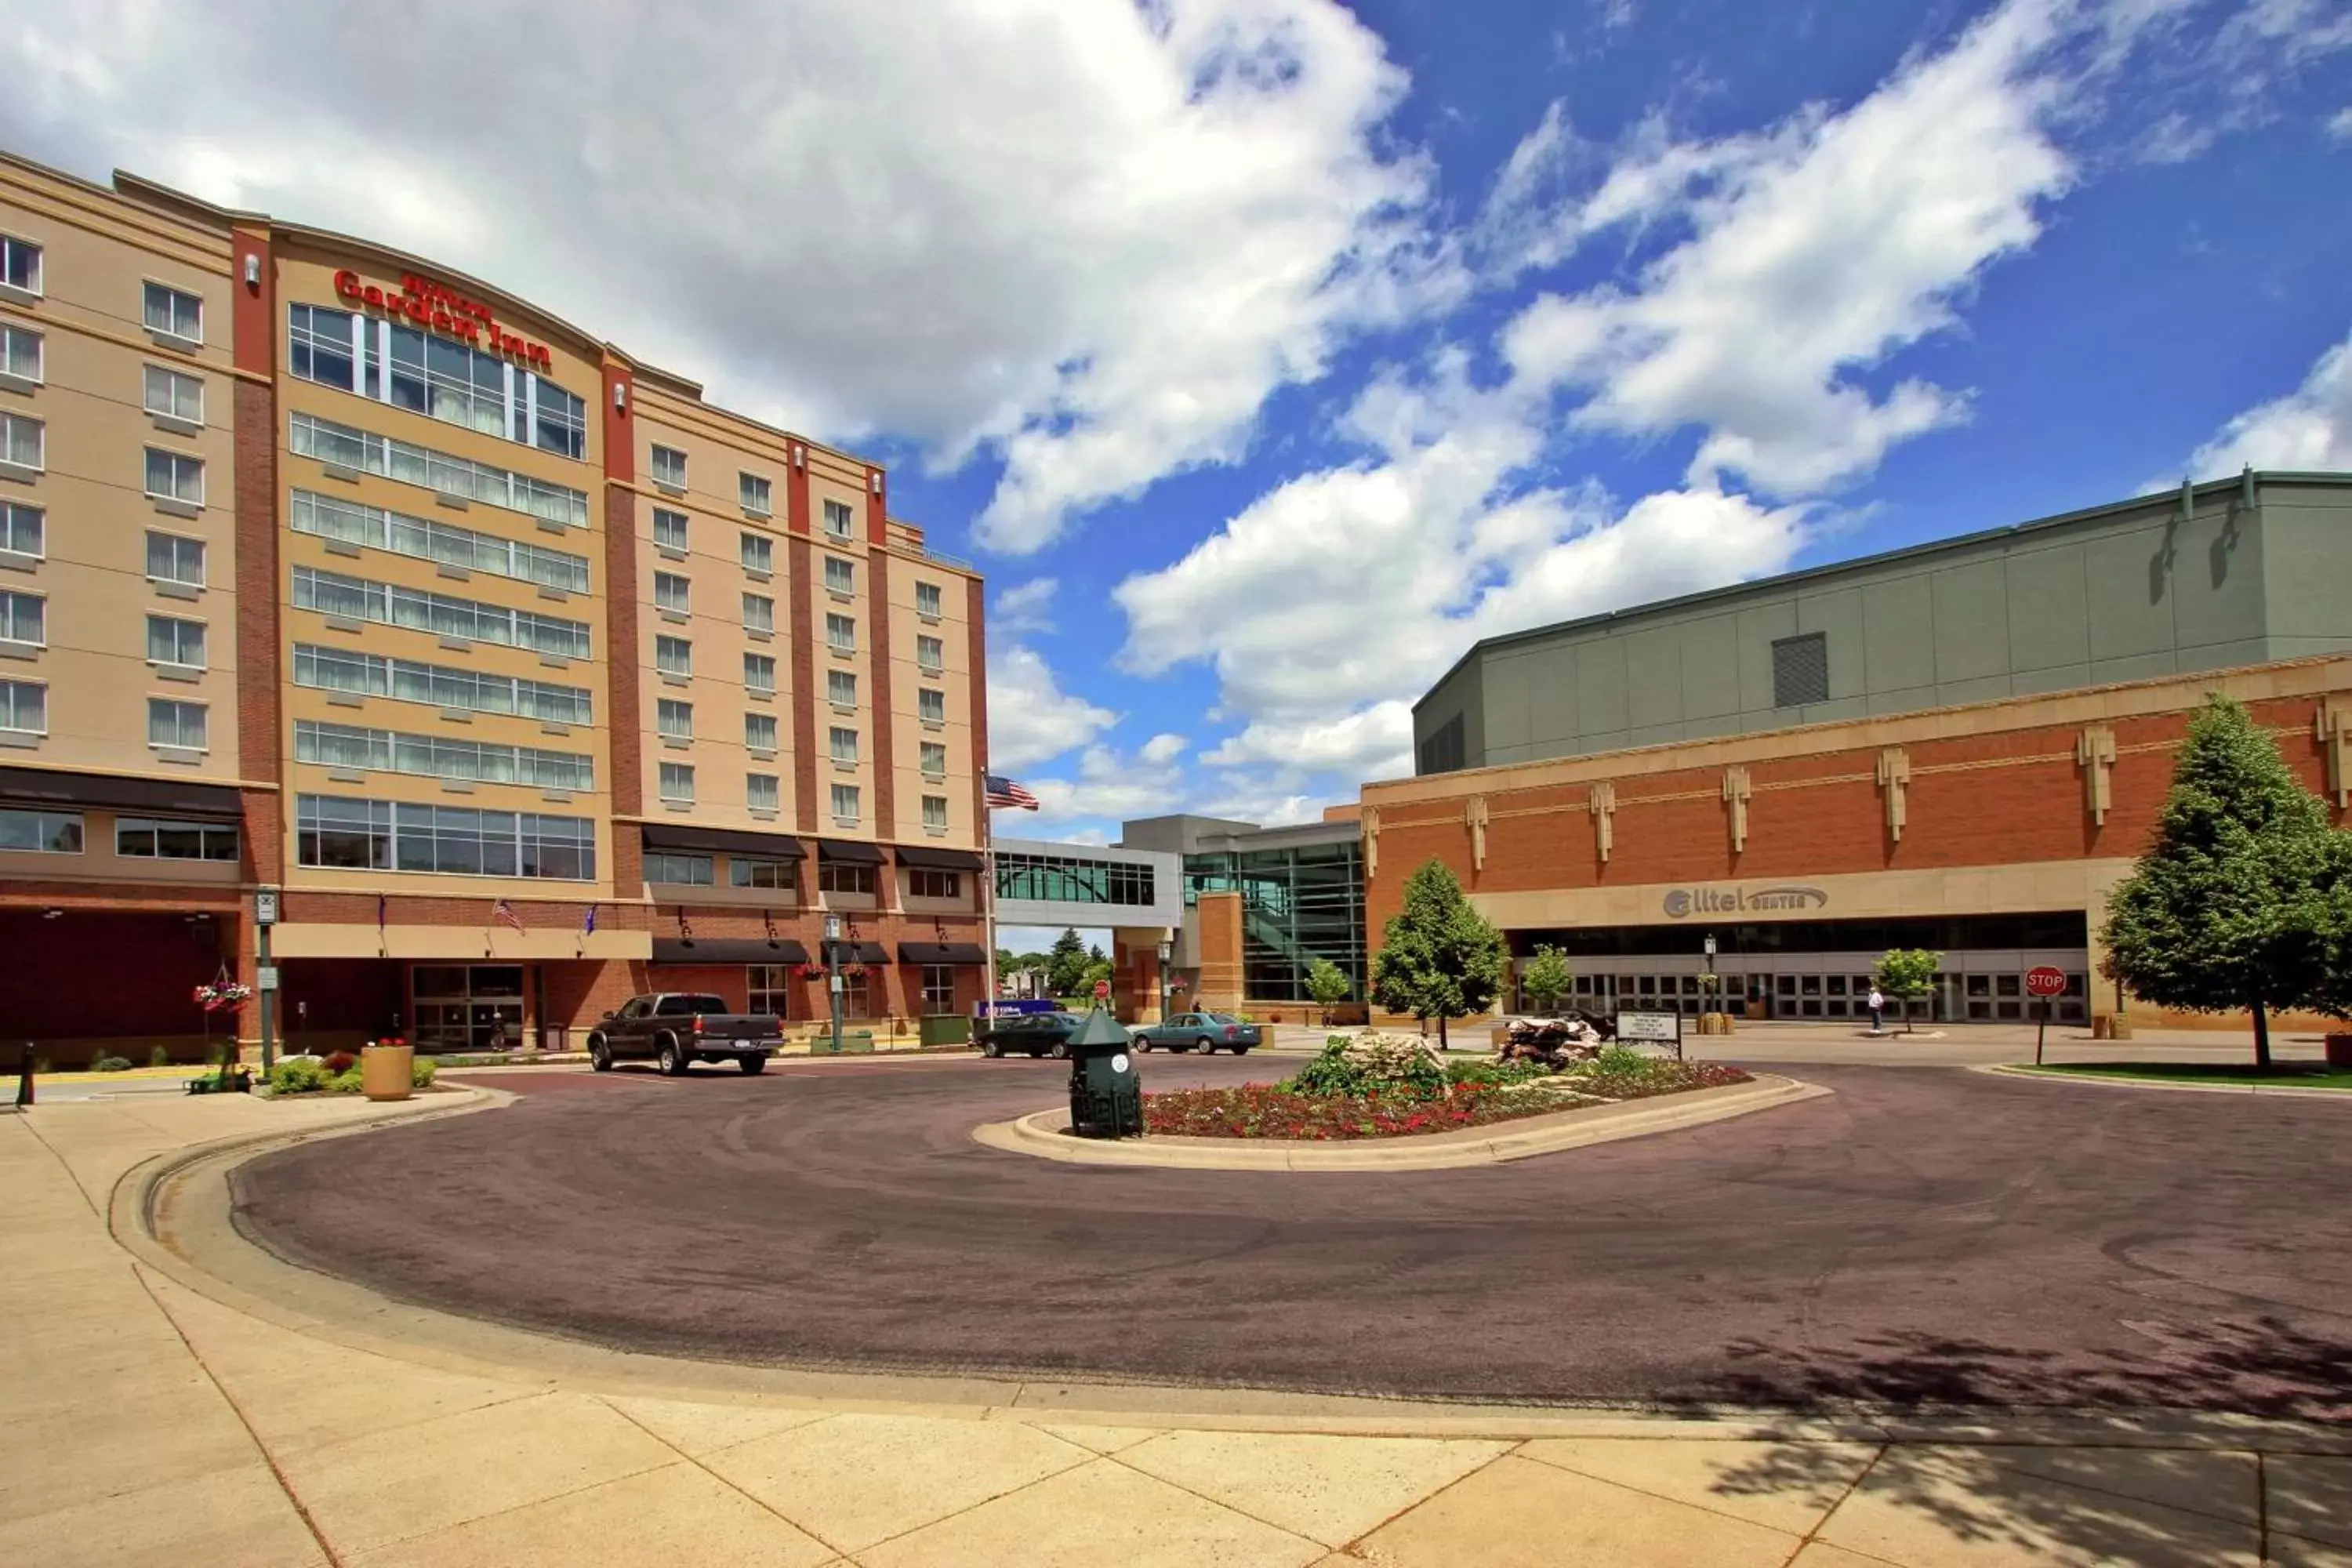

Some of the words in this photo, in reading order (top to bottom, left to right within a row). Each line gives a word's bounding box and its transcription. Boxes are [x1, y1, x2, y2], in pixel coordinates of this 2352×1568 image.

[334, 270, 477, 341] Garden
[488, 323, 552, 366] Inn
[1751, 895, 1806, 911] CENTER
[2027, 975, 2063, 987] STOP
